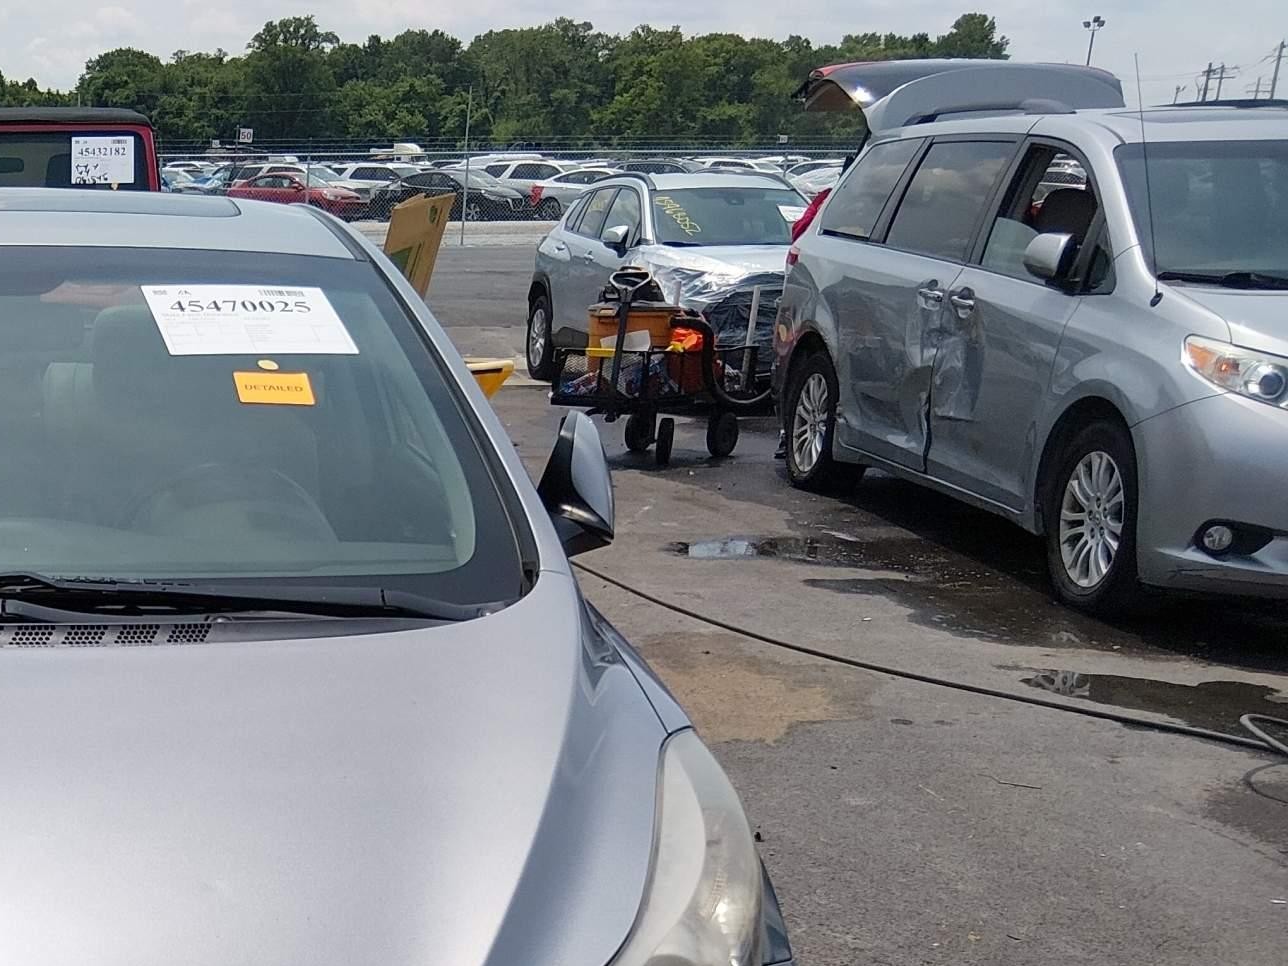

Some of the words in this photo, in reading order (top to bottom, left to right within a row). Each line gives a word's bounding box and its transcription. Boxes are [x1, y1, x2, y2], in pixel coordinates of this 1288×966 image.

[241, 131, 252, 140] 50
[78, 147, 127, 156] 45432182
[170, 300, 311, 313] 45470025
[244, 384, 304, 392] DETAILED
